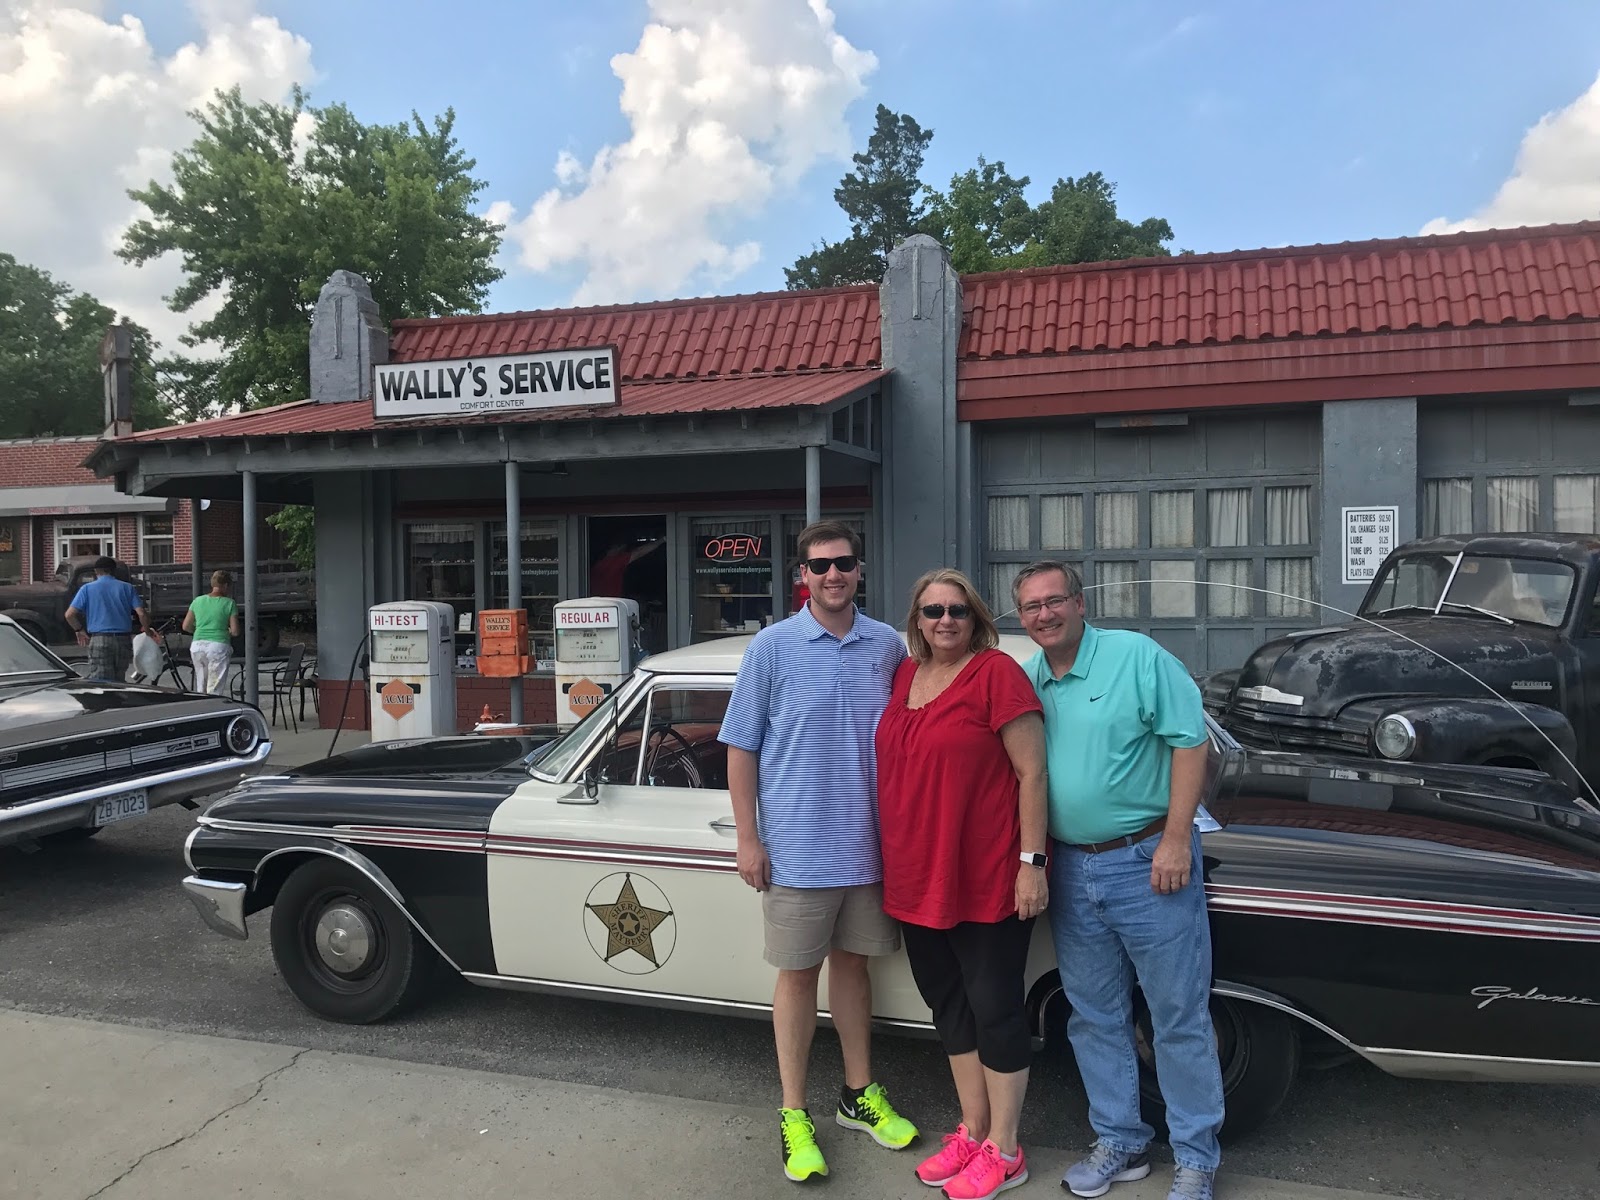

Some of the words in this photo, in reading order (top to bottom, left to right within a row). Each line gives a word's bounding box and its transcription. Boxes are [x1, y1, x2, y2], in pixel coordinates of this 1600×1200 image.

[379, 361, 488, 402] WALLY'S
[499, 356, 611, 396] SERVICE
[460, 401, 495, 410] COMFORT
[496, 399, 525, 409] CENTER
[1350, 514, 1375, 522] BATTERIES
[1358, 525, 1376, 533] CHANGES
[1350, 536, 1363, 544] LUBE
[705, 537, 762, 558] OPEN
[1350, 547, 1362, 555] TUNE
[1363, 547, 1373, 555] UPS
[1350, 558, 1366, 566] WASH
[1350, 568, 1362, 576] FLATS
[1362, 568, 1374, 576] FIXED
[374, 615, 419, 626] HI-TEST
[561, 612, 610, 624] REGULAR
[383, 694, 413, 704] ACME
[611, 903, 647, 920] SHERIFF
[610, 922, 649, 945] MAYBERRY
